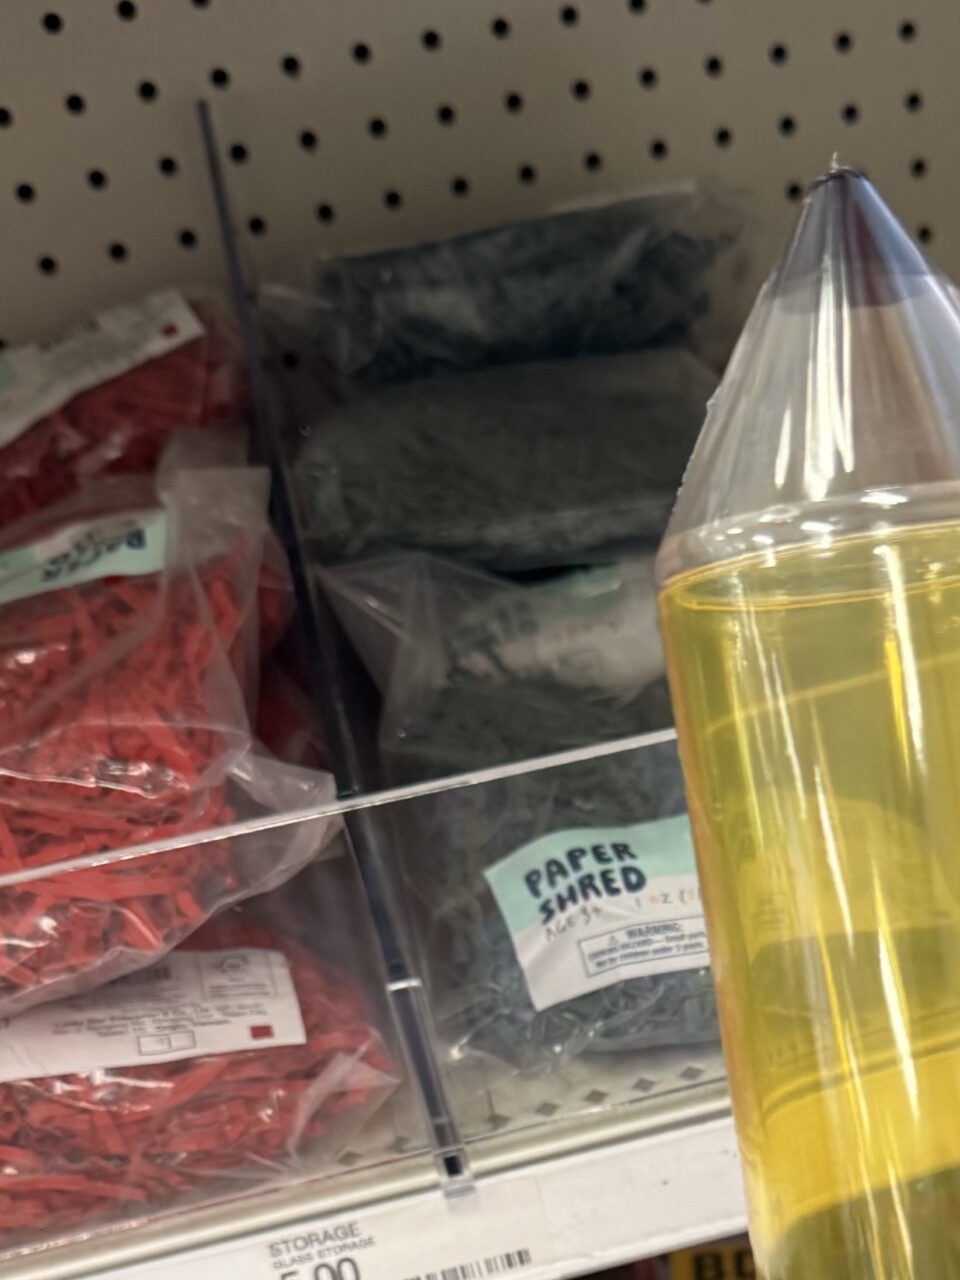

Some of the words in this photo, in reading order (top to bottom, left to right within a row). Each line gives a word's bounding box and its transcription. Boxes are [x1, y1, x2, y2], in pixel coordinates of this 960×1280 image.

[525, 843, 637, 897] PAPER
[539, 866, 647, 925] SHRED
[269, 1221, 361, 1258] STORAGE
[318, 1237, 375, 1258] STORAGE
